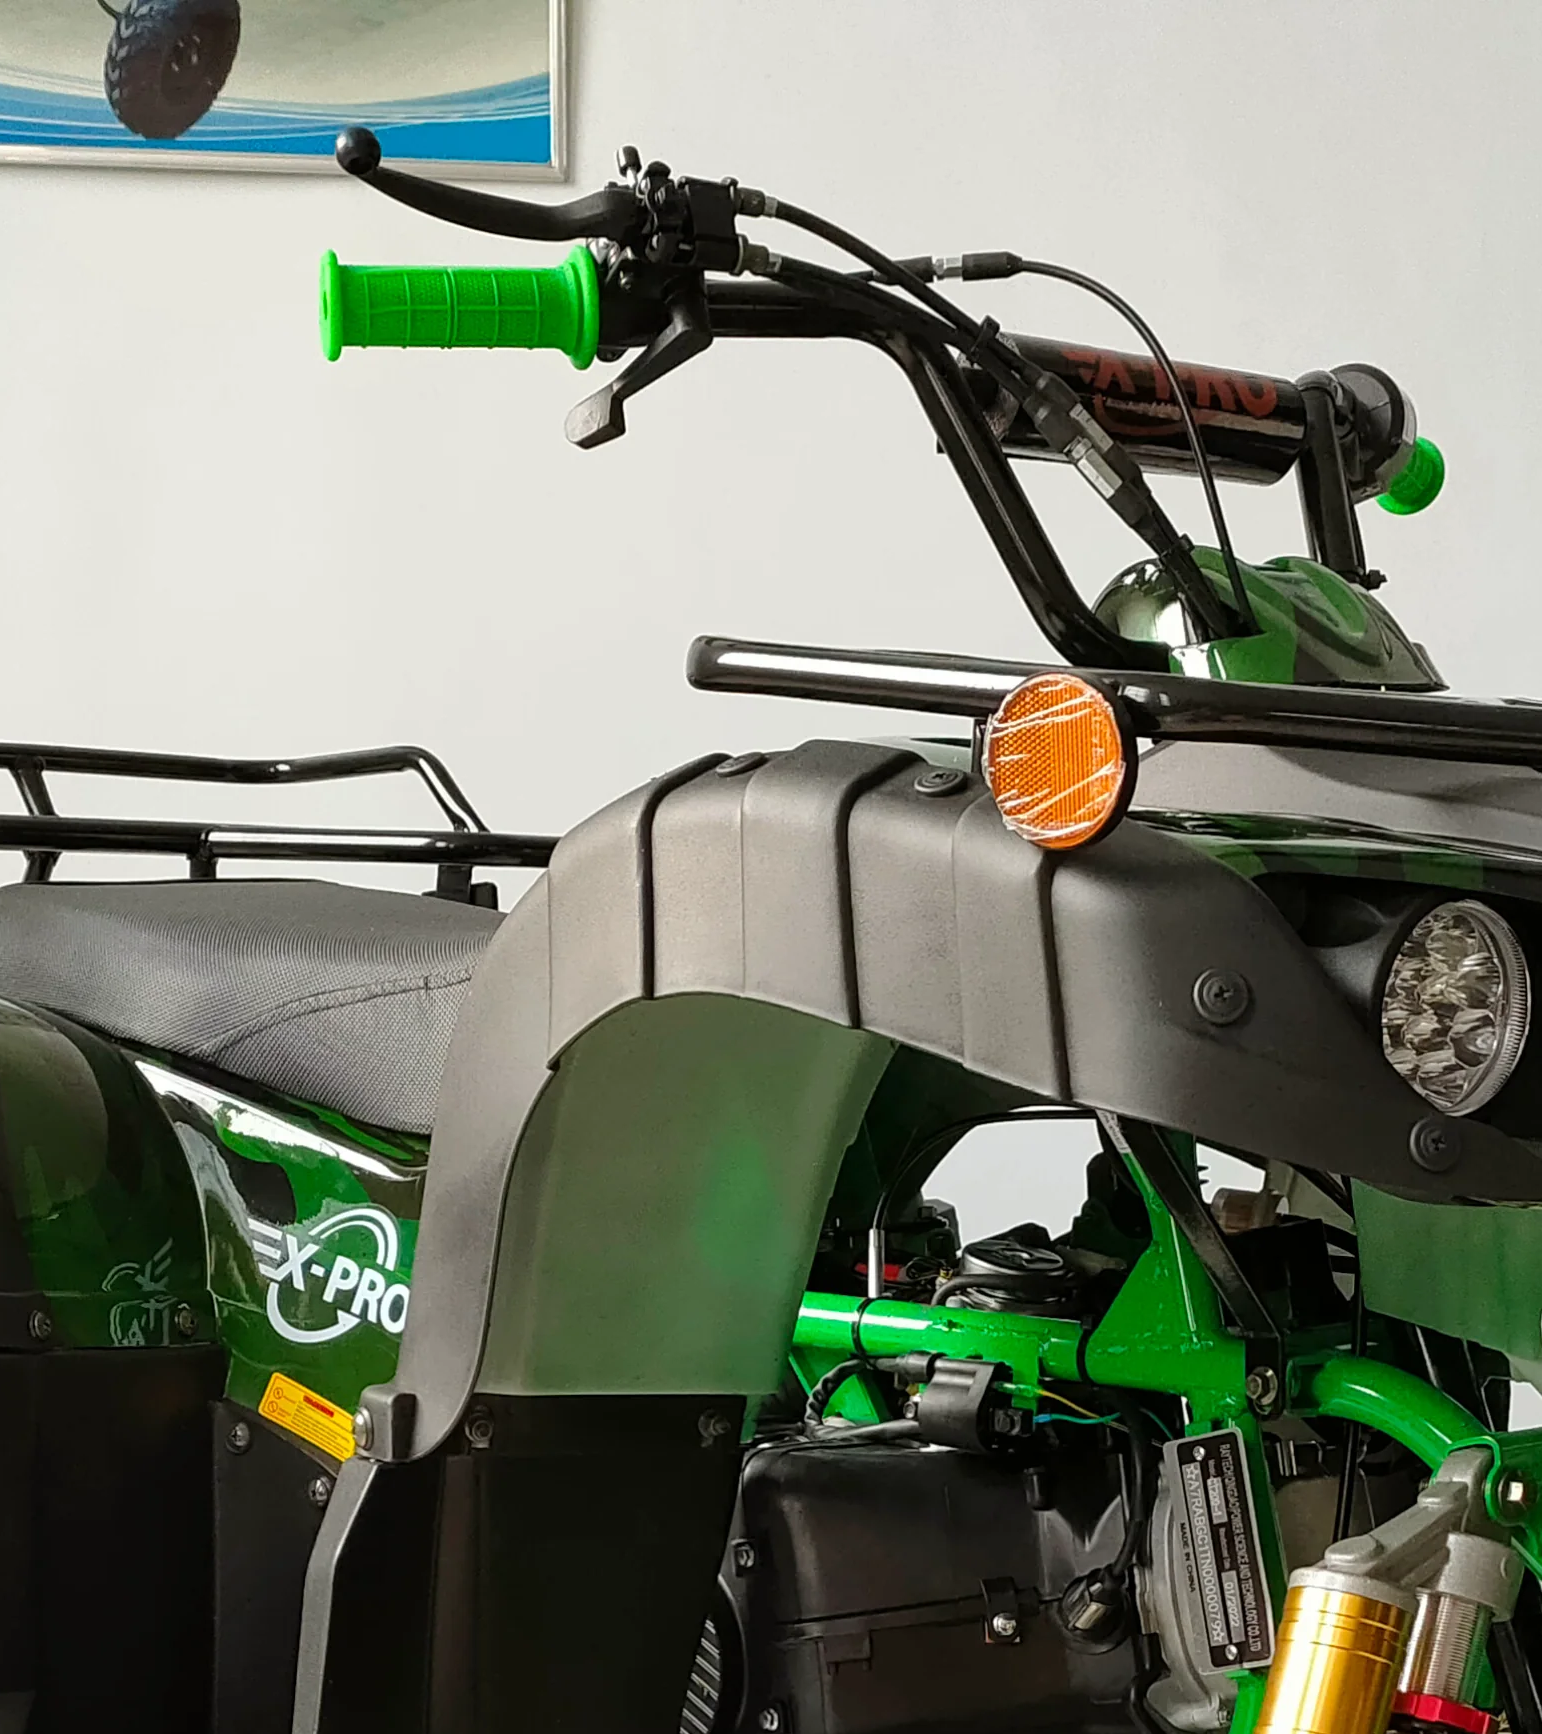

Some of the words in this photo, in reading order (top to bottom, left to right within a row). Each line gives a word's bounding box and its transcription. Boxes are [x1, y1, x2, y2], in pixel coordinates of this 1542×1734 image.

[1179, 1522, 1189, 1549] MADE
[1183, 1551, 1191, 1561] IN
[1185, 1564, 1196, 1592] CHINA
[1223, 1580, 1240, 1628] 01/2022
